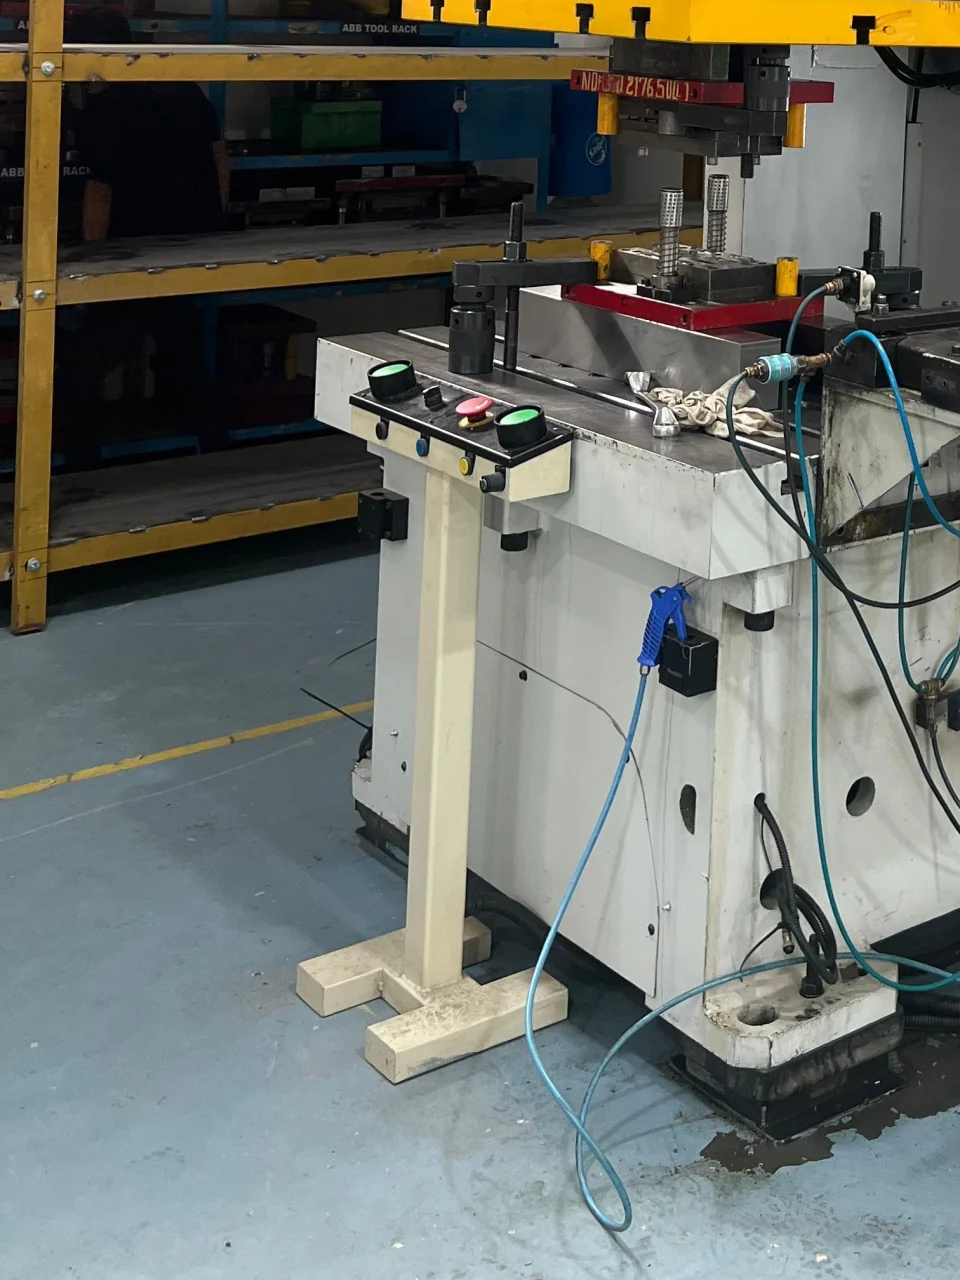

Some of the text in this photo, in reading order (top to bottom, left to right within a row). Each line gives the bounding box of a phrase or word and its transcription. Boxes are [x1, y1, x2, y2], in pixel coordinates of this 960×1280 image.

[342, 23, 418, 34] ABB TOOL RACK
[0, 167, 25, 178] ABB
